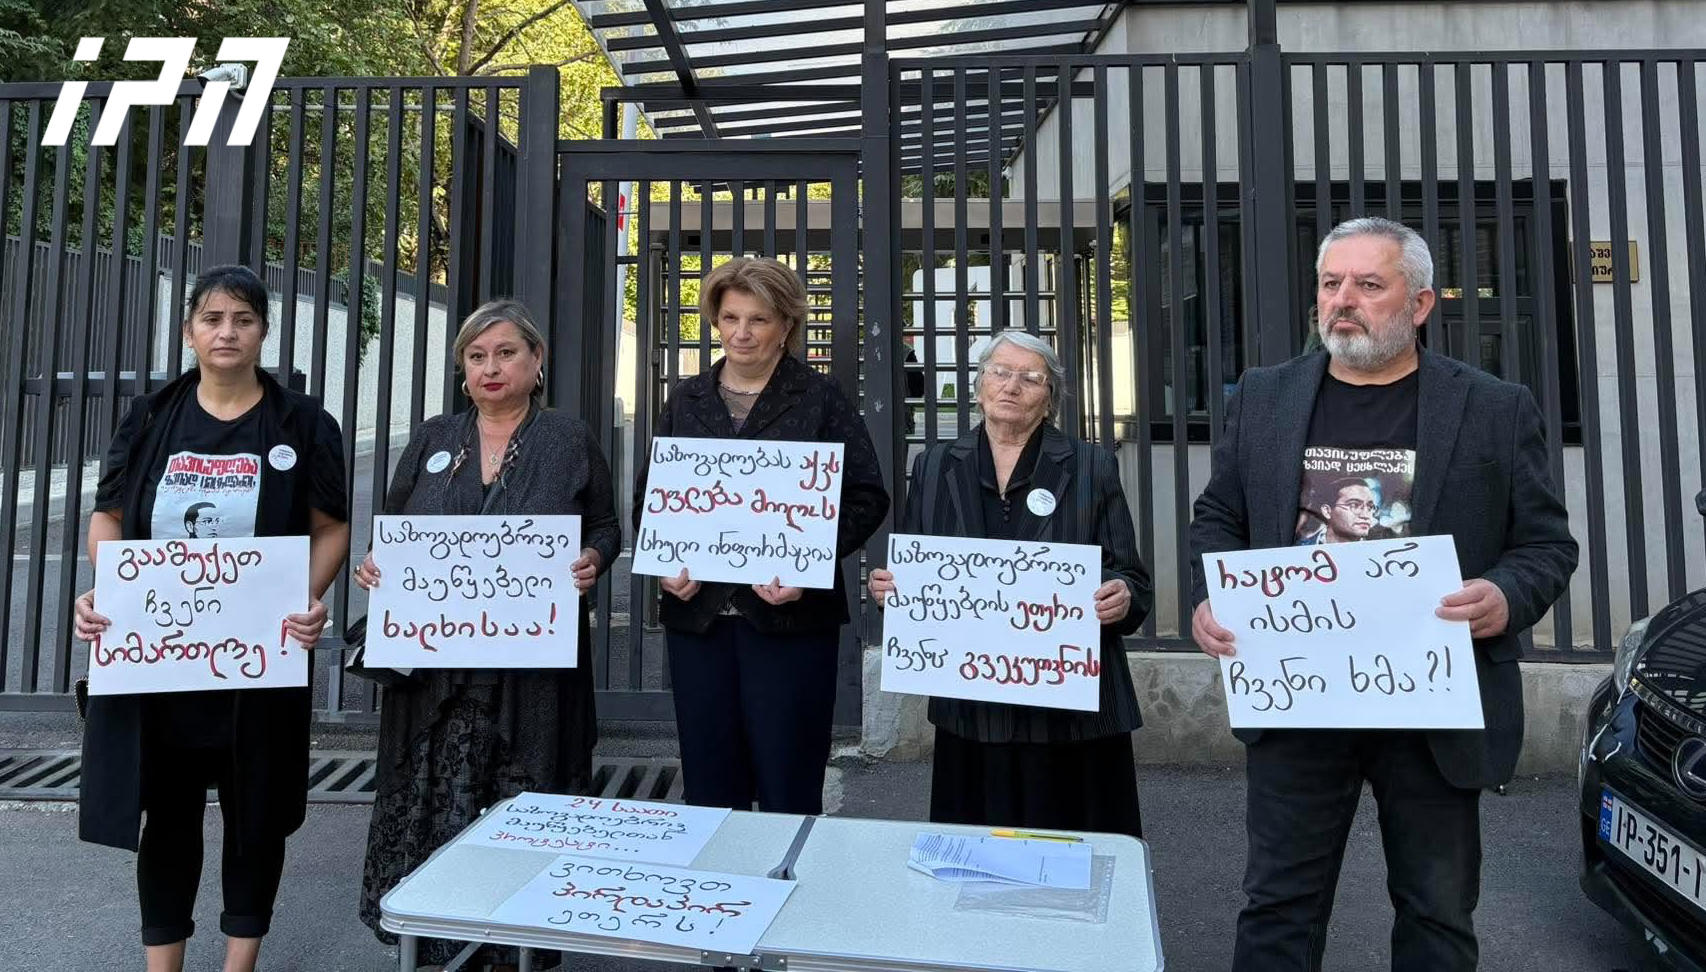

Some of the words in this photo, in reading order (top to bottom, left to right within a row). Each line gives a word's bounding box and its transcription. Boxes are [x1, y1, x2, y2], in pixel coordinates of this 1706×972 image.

[653, 441, 791, 477] საზოგადოებას
[799, 450, 840, 491] აქვს
[648, 480, 743, 514] უფლება
[379, 519, 569, 559] საზოგადოებრივი
[640, 527, 700, 562] სრული
[708, 530, 833, 572] ინფორმაცია
[117, 541, 262, 585] გააშუქეთ
[891, 538, 1085, 585] საზოგადოებრივი
[1217, 550, 1338, 597] რატომ
[1365, 542, 1420, 578] არ
[402, 564, 552, 601] მაუწყებელი
[145, 586, 222, 628] ჩვენი
[383, 602, 556, 652] ხალხისაა!
[1010, 593, 1083, 632] ეთერი
[1250, 598, 1356, 634] ისმის
[888, 636, 948, 672] ჩვენც
[1230, 656, 1327, 712] ჩვენი
[567, 797, 602, 810] 24
[612, 801, 678, 818] საათი
[549, 862, 731, 894] ვითხოვთ
[552, 882, 752, 917] პირდაპირ
